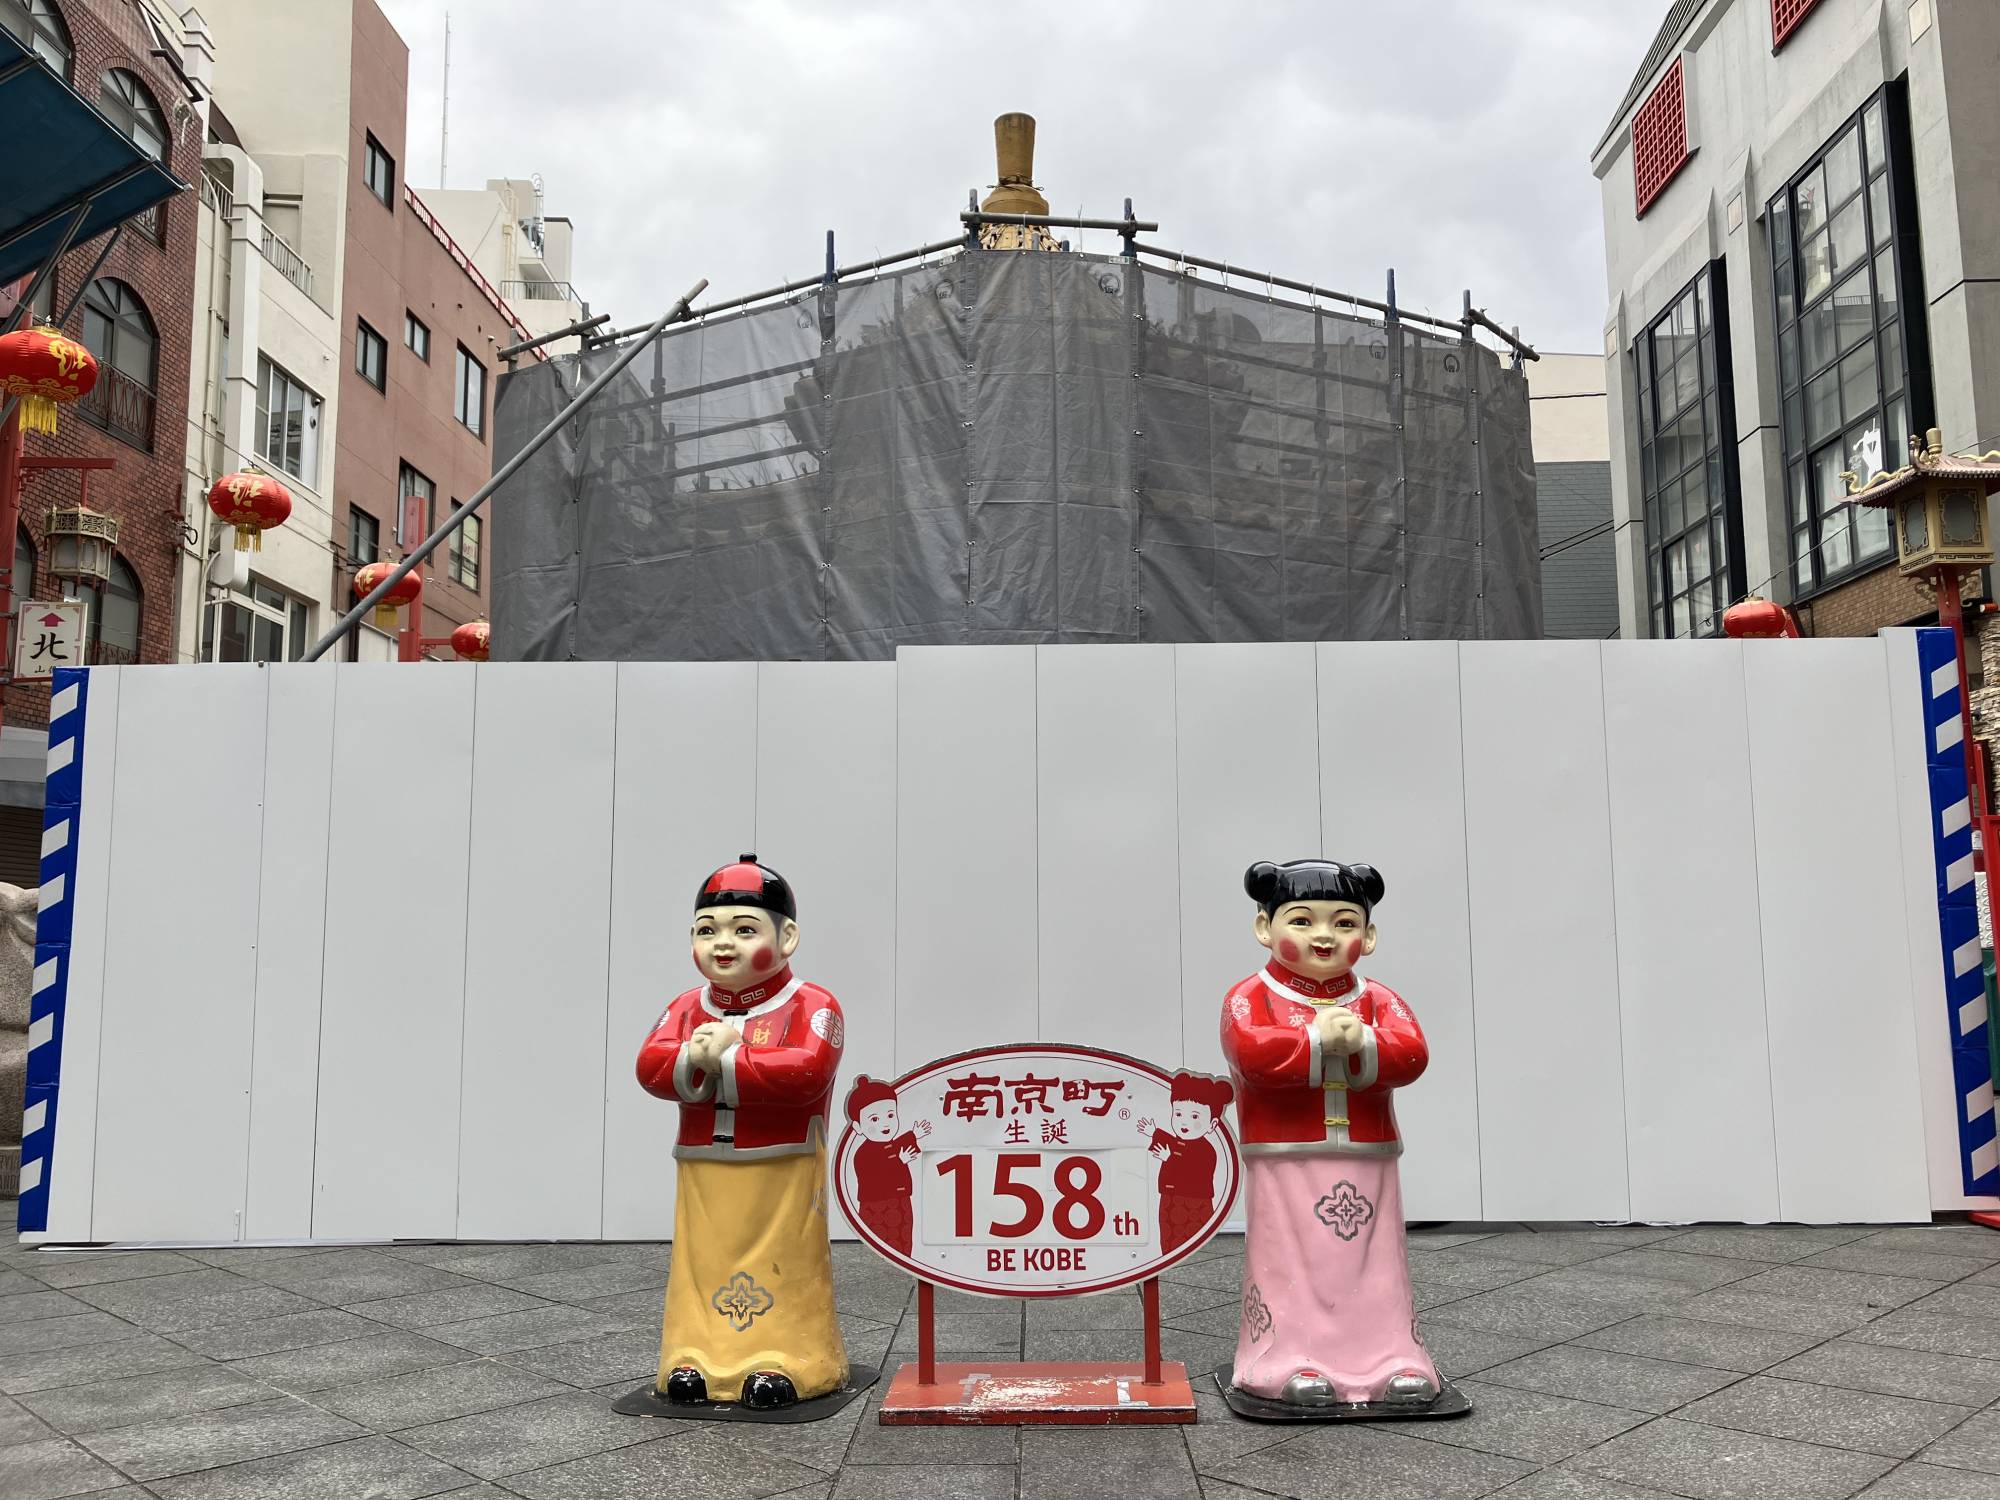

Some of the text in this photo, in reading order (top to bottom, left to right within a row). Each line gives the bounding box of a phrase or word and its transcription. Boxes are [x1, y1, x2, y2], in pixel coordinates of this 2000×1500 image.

[30, 632, 68, 659] 北
[751, 1027, 771, 1044] 財
[943, 1072, 1125, 1122] 南京町
[1004, 1119, 1069, 1144] 生誕
[987, 1248, 1087, 1271] BE KOBE
